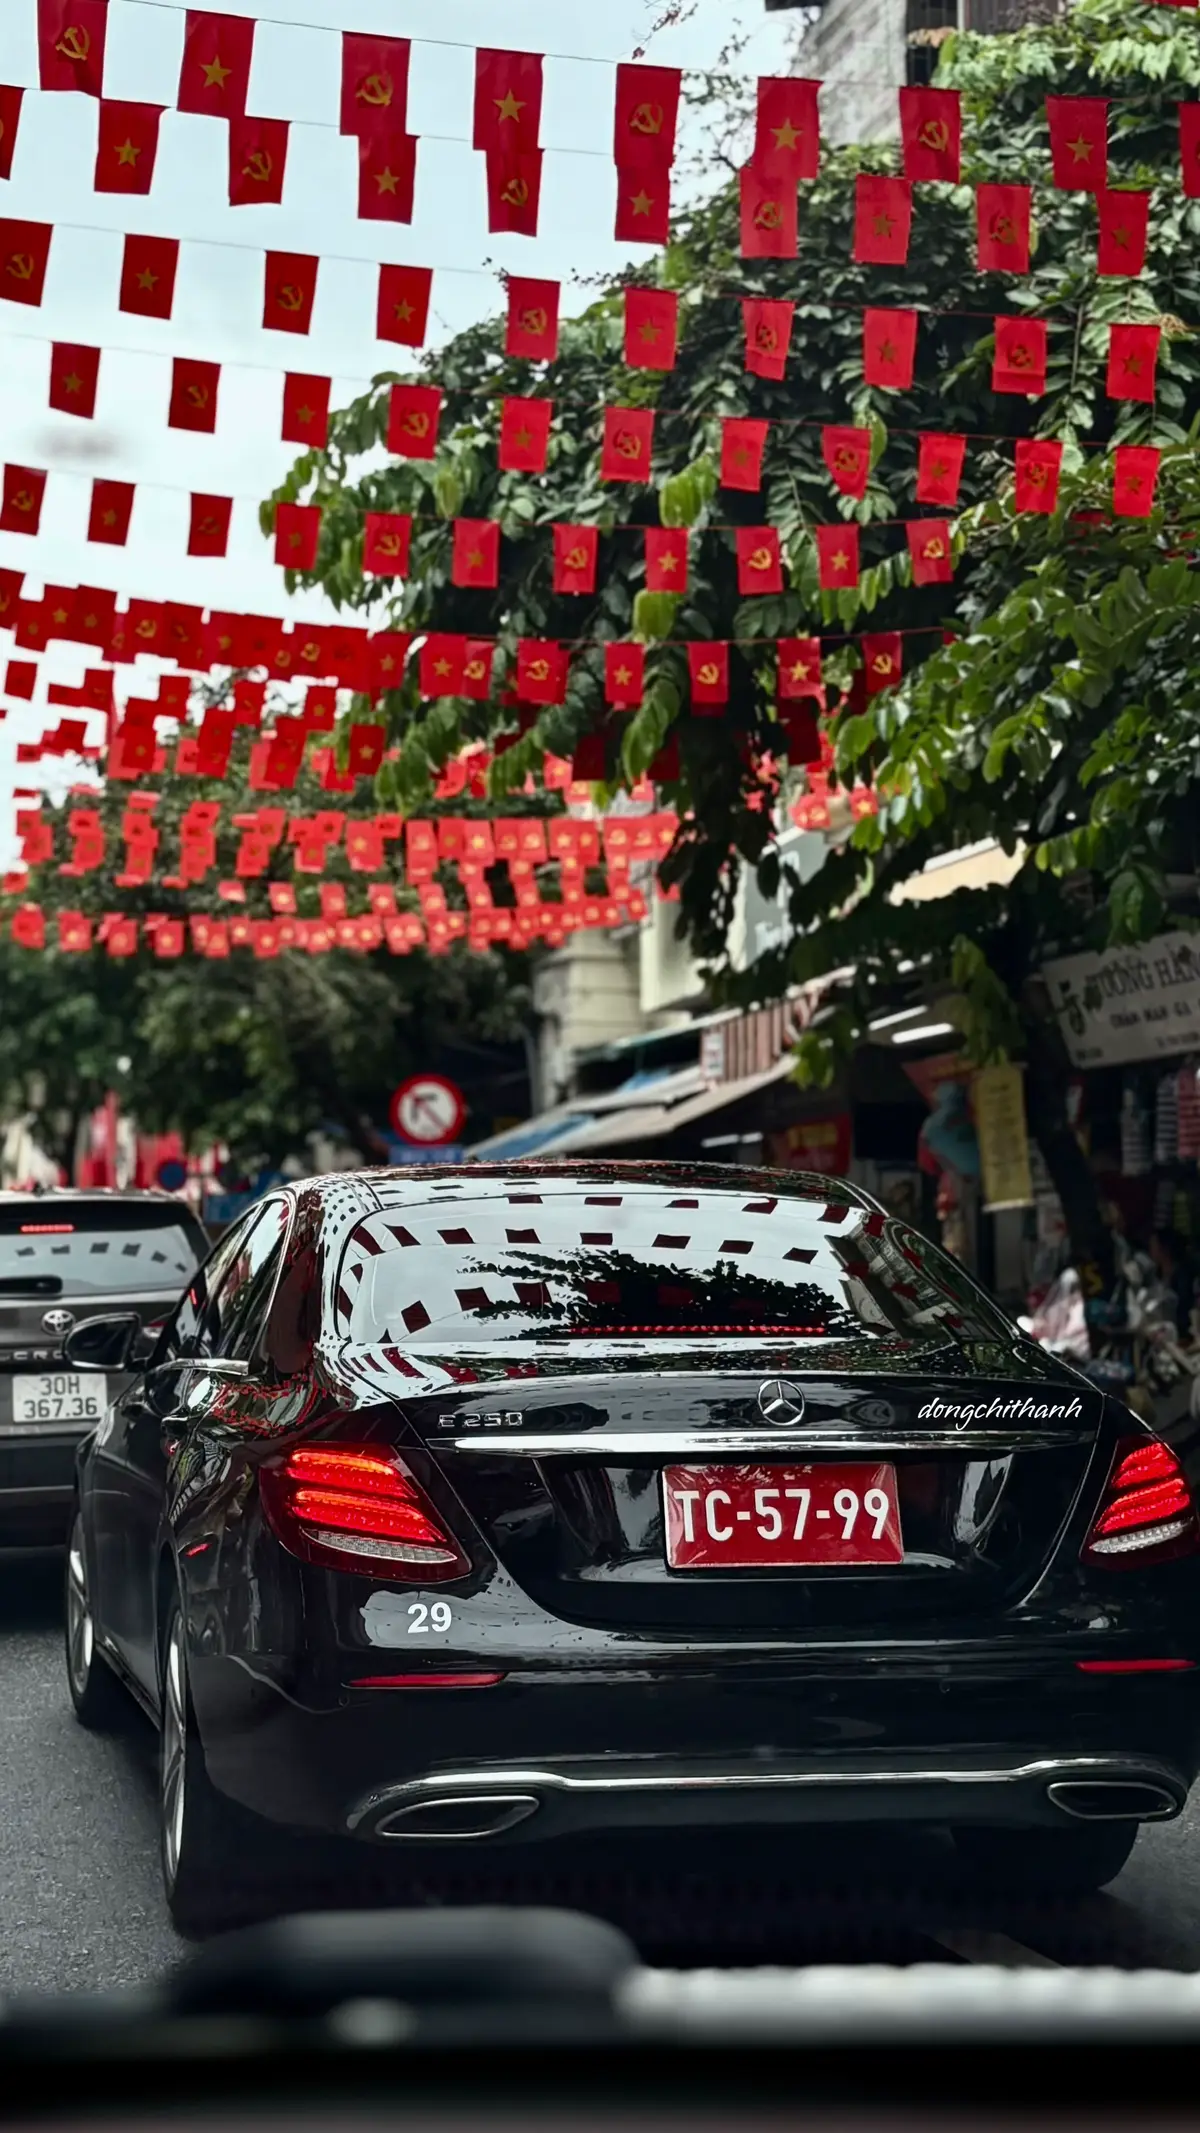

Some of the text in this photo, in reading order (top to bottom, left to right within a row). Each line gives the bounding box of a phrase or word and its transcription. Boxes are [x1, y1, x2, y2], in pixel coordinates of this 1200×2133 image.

[40, 1375, 80, 1396] 30H
[23, 1397, 98, 1419] 367.36
[438, 1412, 523, 1428] E 250
[673, 1488, 890, 1542] TC-57-99
[407, 1601, 452, 1634] 29
